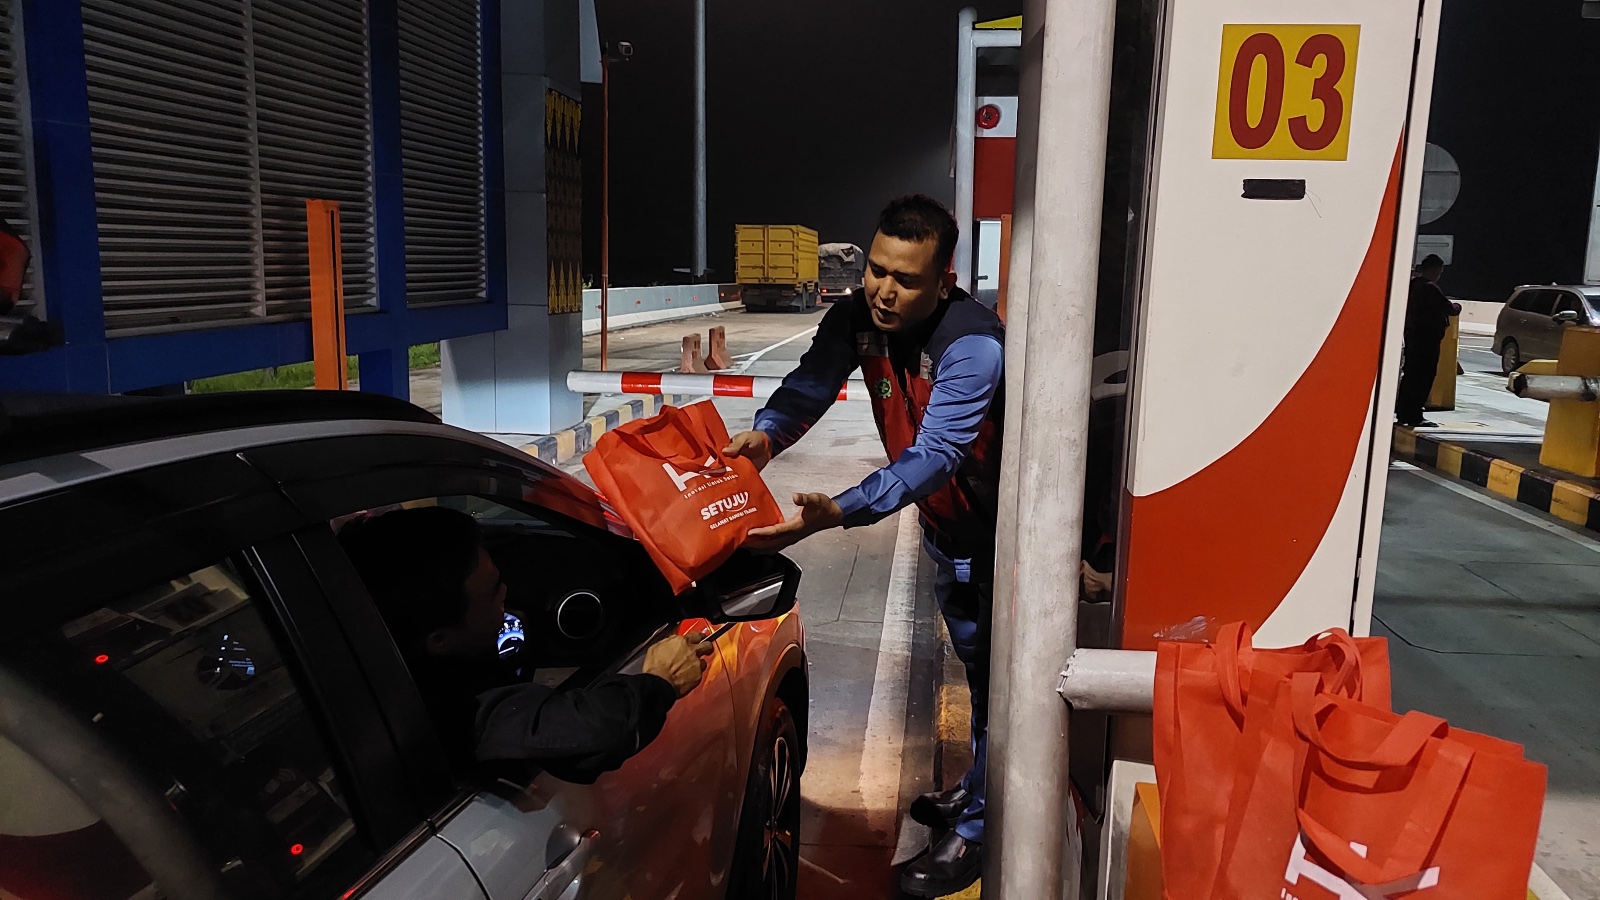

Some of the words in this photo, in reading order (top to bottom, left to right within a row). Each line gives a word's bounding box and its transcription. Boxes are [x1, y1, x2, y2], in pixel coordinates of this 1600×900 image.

[1228, 32, 1346, 151] 03
[706, 478, 724, 487] Untuk
[700, 491, 749, 520] SETUJU
[709, 517, 730, 530] SELAMAT
